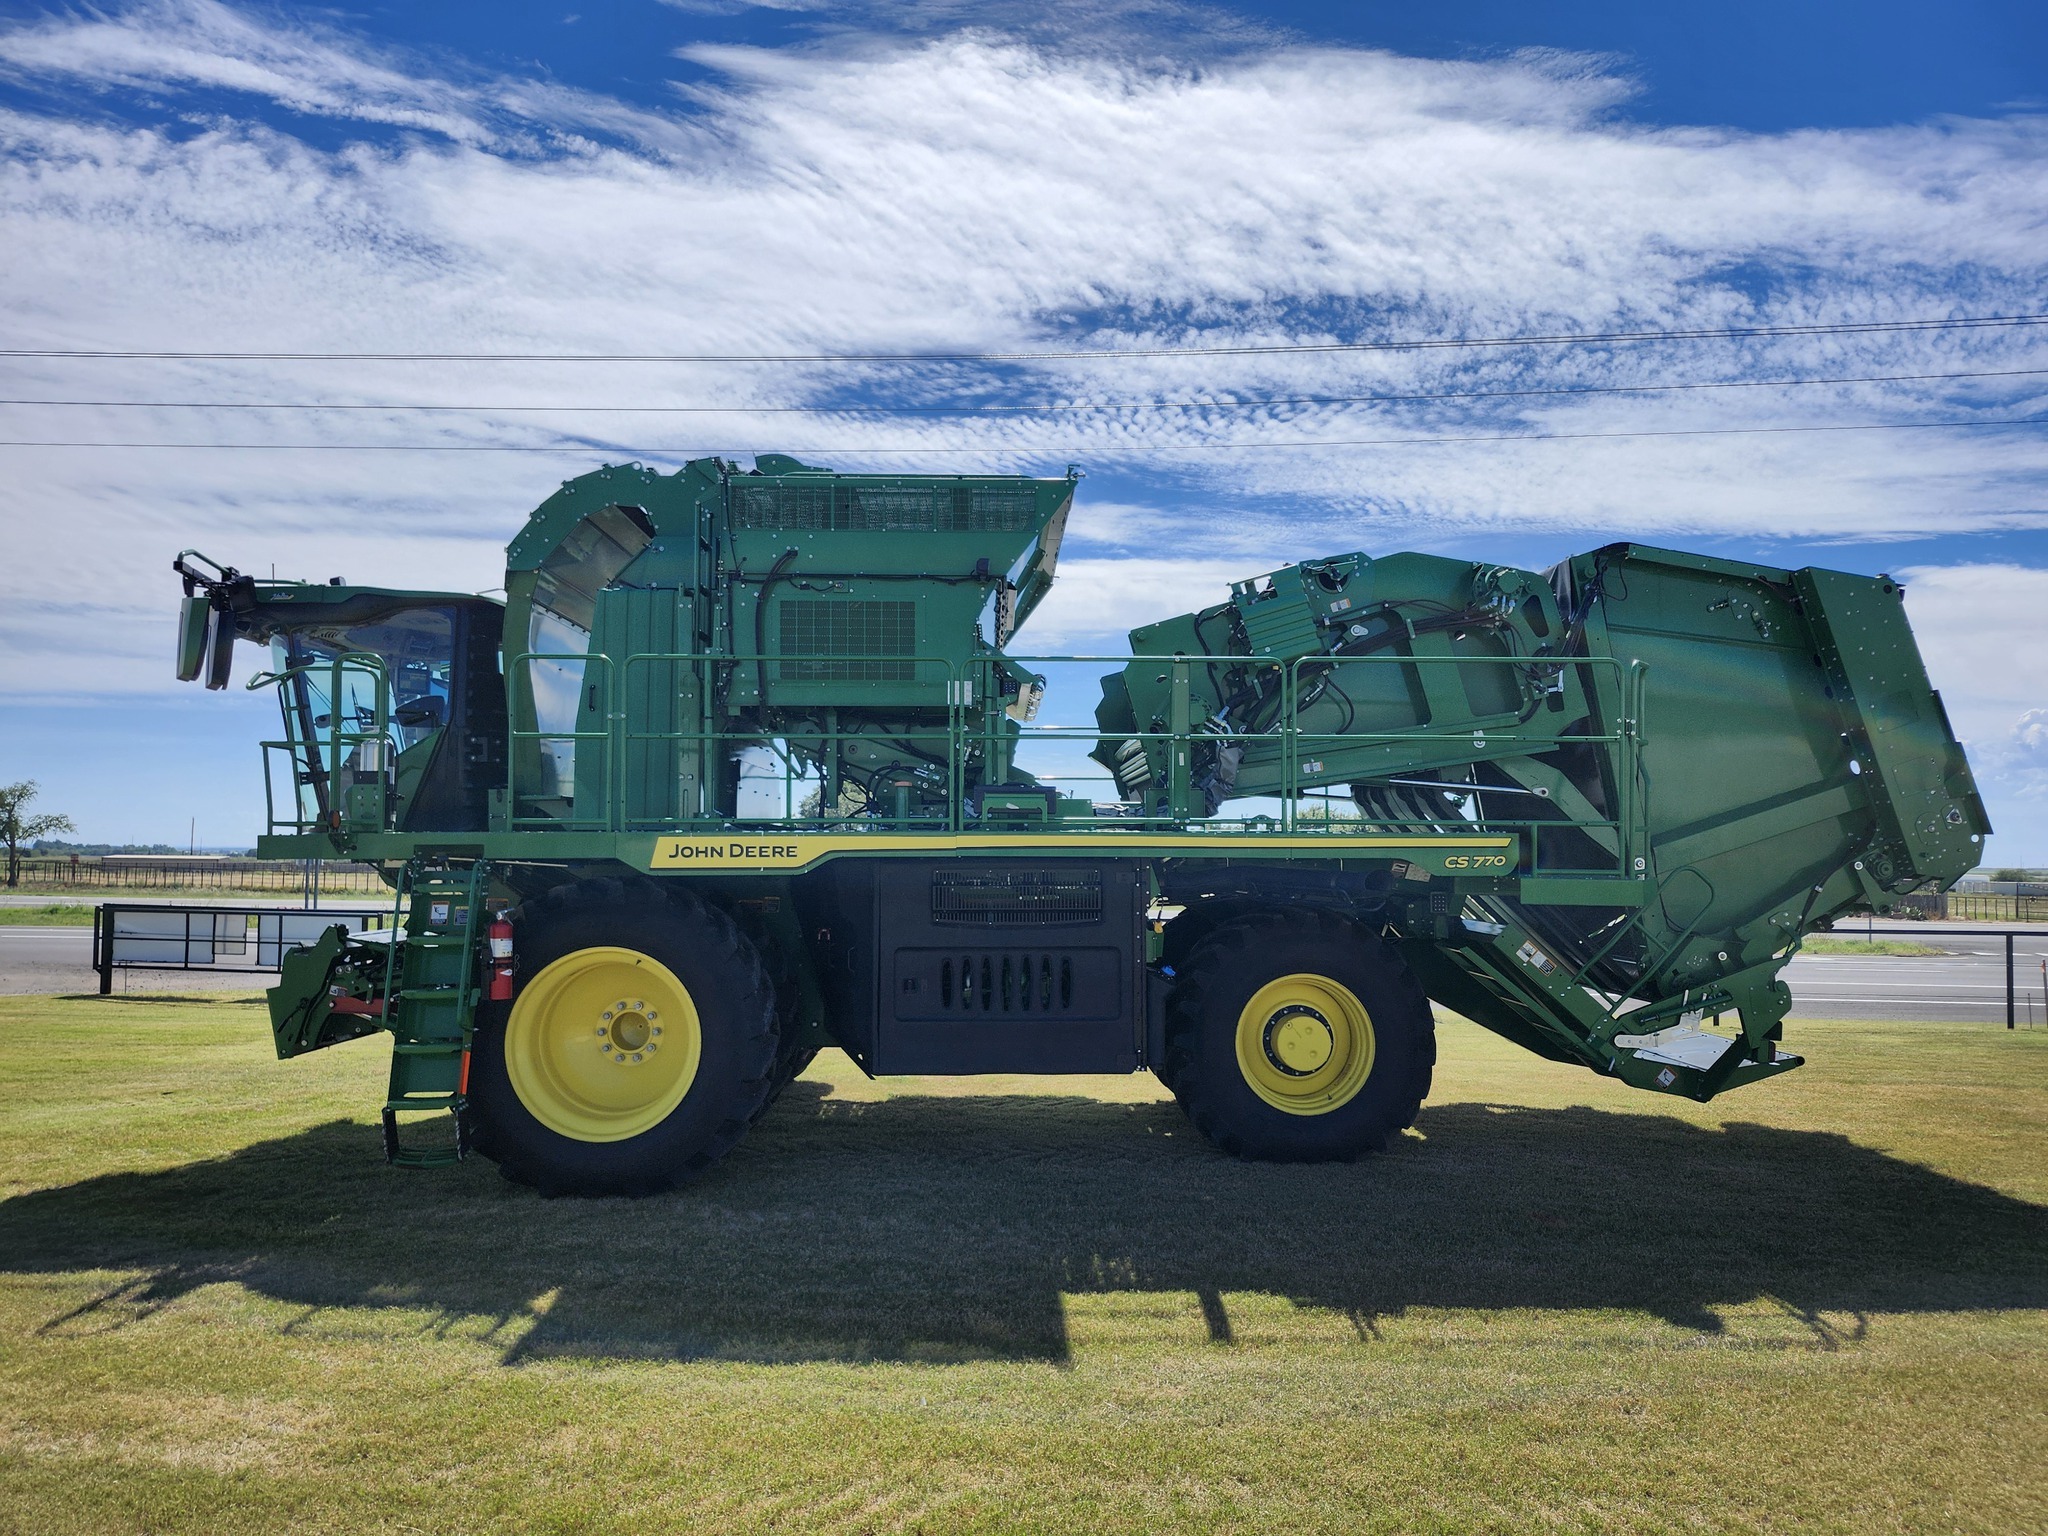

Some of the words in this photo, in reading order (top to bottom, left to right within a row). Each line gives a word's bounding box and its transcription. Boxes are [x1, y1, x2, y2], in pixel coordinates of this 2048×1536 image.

[668, 843, 724, 859] JOHN
[729, 843, 798, 859] DEERE
[1444, 856, 1469, 869] CS
[1472, 855, 1506, 869] 770
